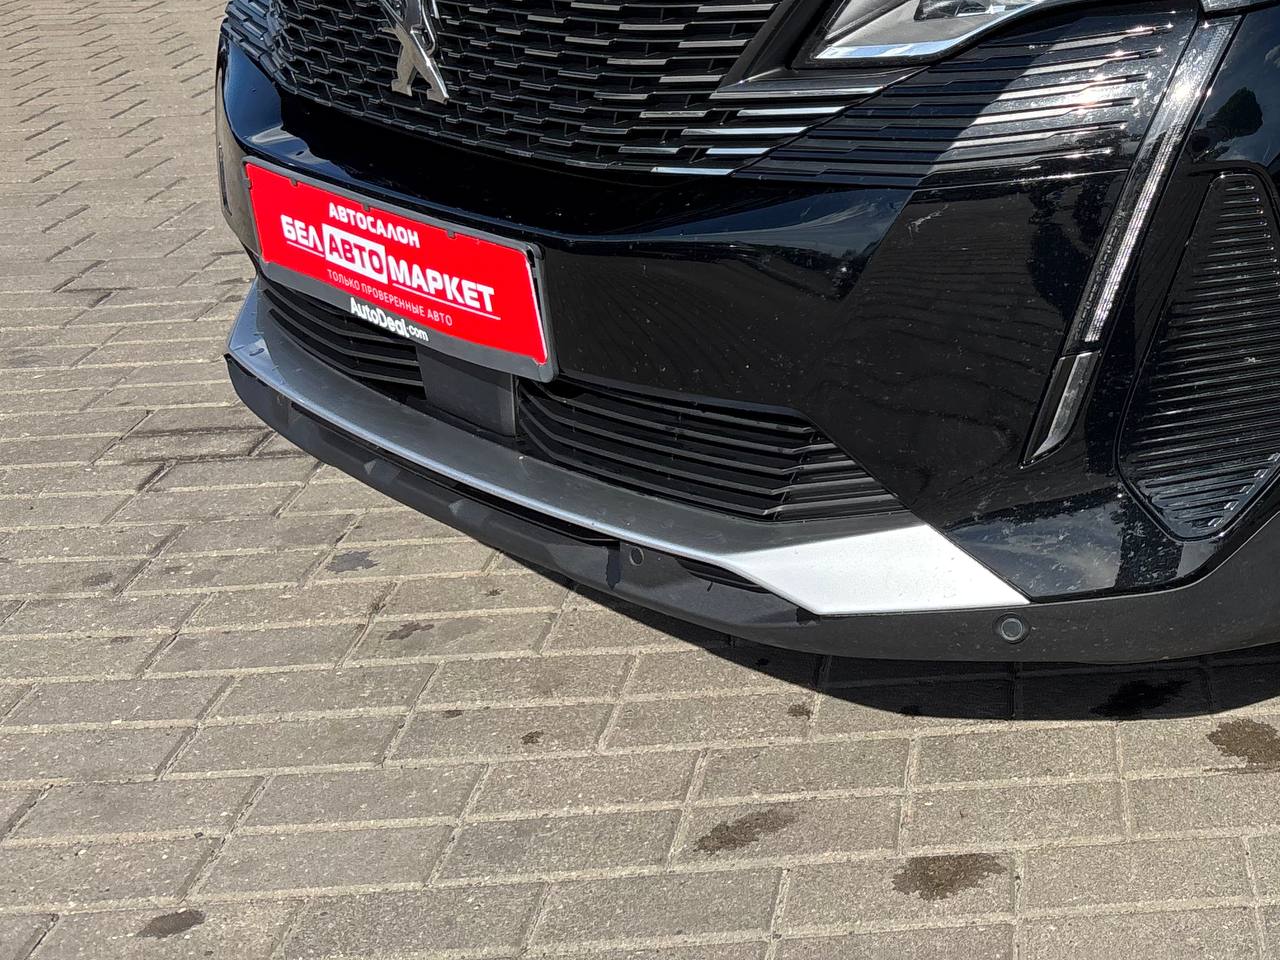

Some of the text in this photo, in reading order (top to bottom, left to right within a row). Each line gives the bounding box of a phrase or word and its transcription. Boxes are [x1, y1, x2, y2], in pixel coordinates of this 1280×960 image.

[328, 201, 421, 249] АВТОСАЛОН
[327, 268, 453, 327] ТОЛЬКО ПРОВЕРЕННЫЕ АВТО
